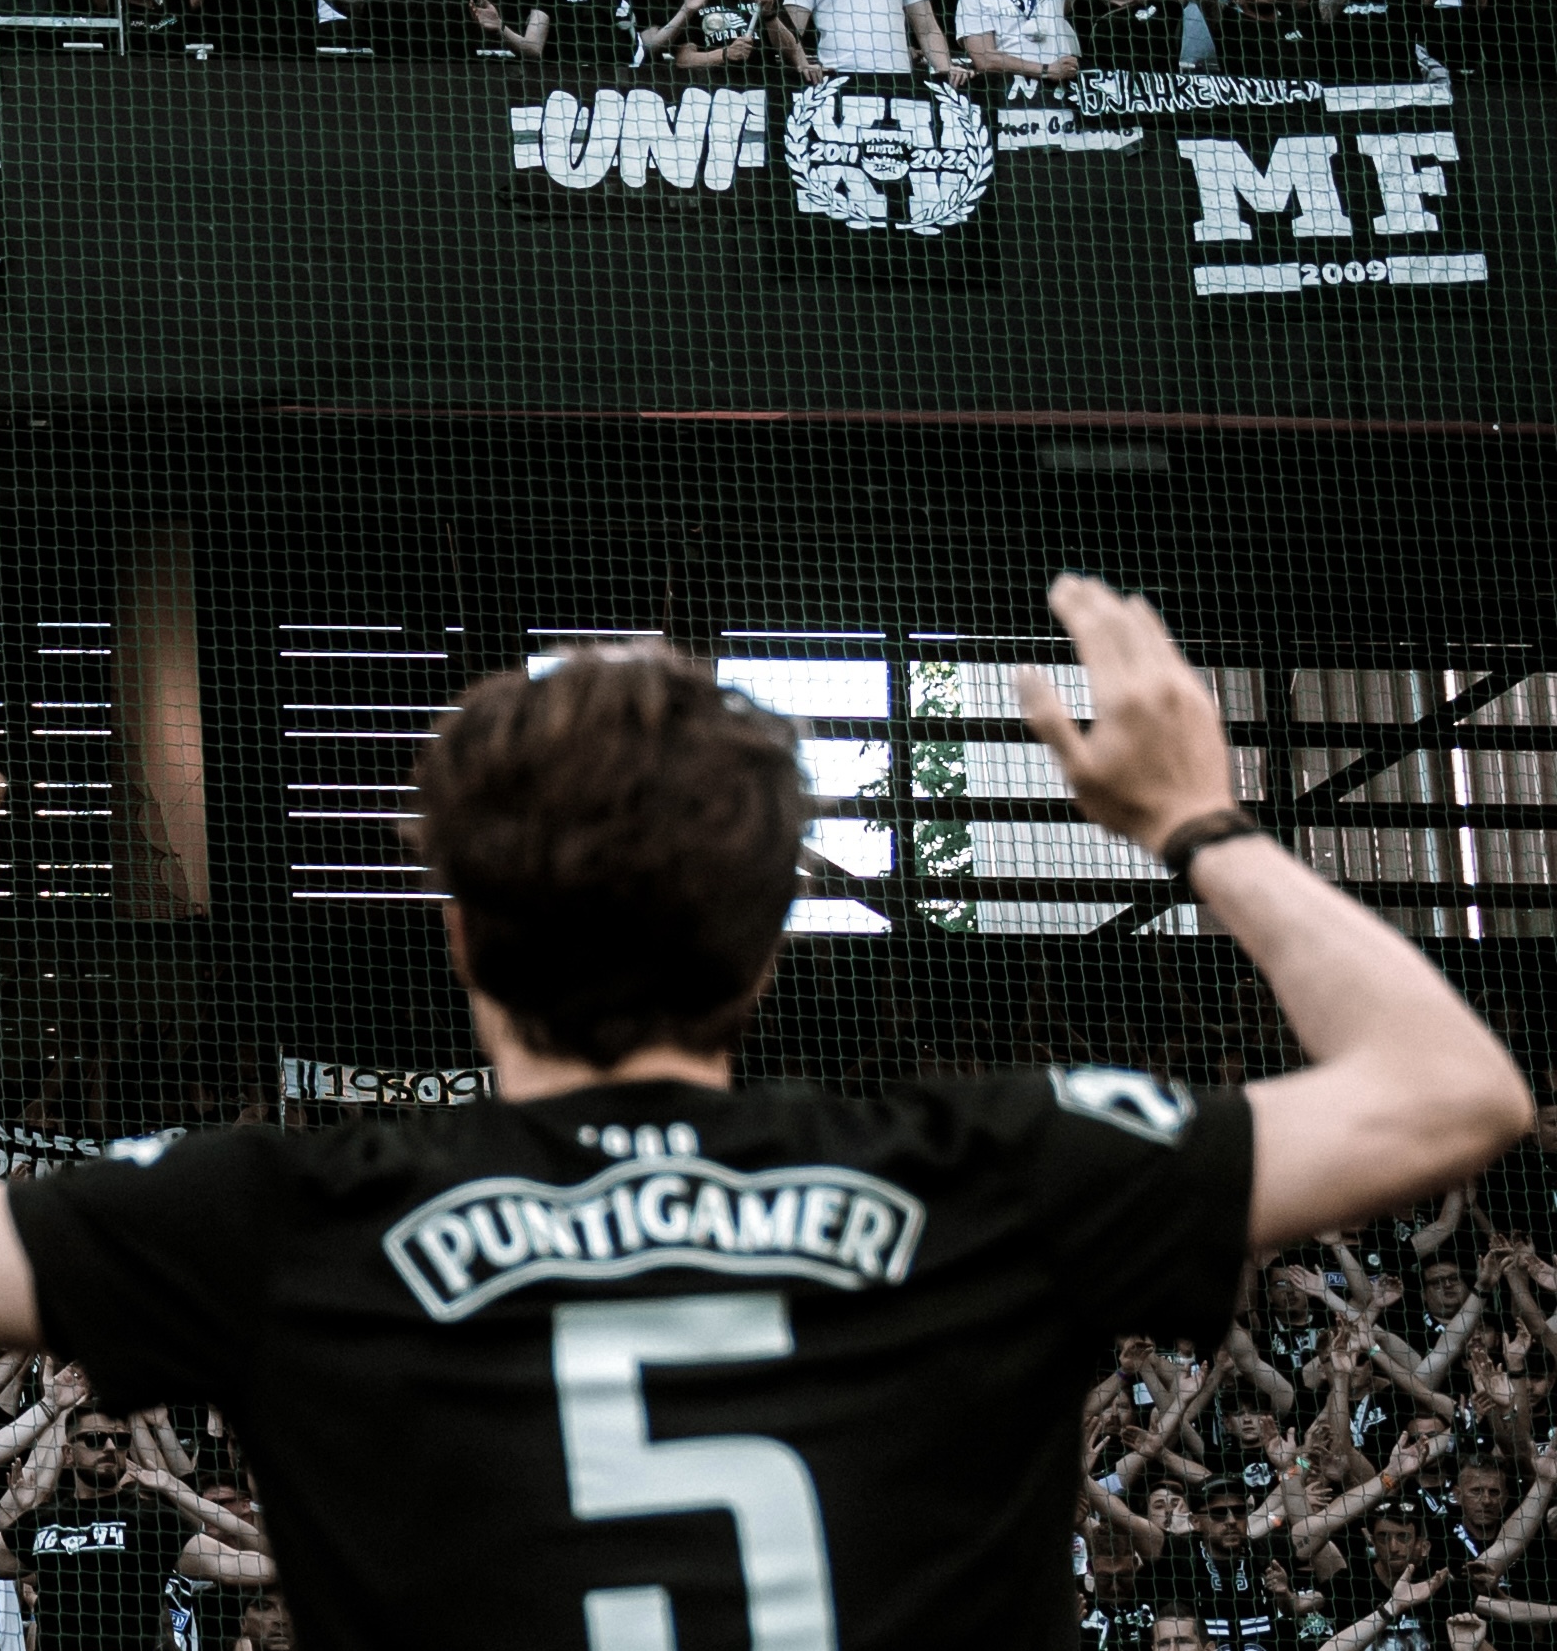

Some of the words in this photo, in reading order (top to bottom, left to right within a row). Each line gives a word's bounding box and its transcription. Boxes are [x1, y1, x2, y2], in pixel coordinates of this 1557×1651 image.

[809, 142, 859, 165] 2011
[909, 148, 970, 171] 2026
[1176, 131, 1461, 243] MF
[1299, 258, 1389, 287] 2009
[423, 1186, 895, 1296] PUNTIGAMER
